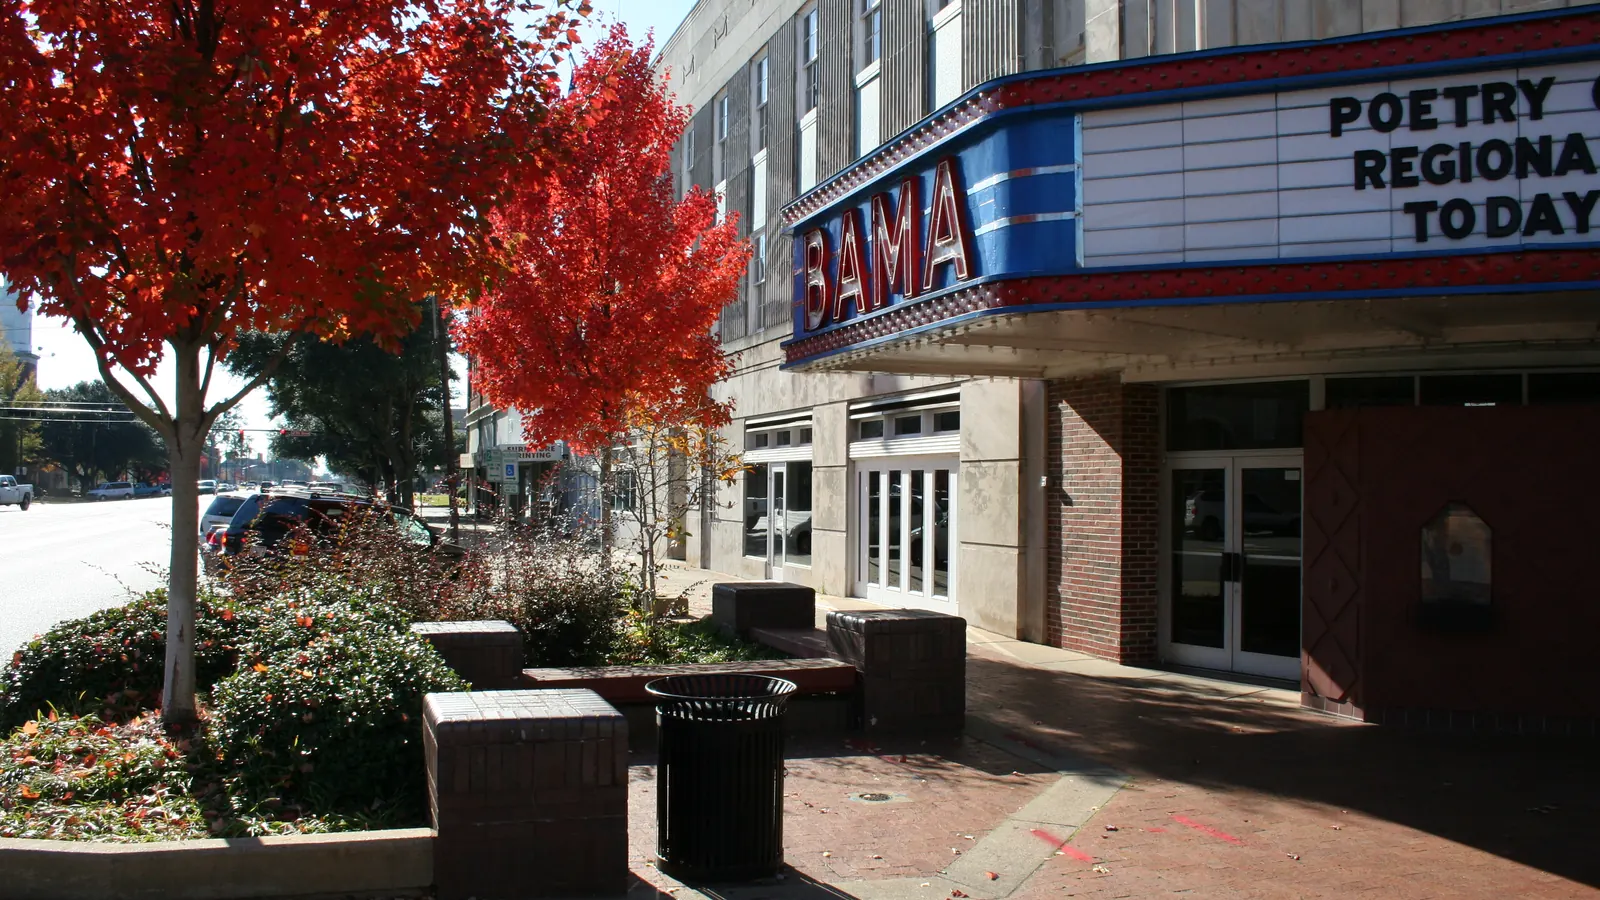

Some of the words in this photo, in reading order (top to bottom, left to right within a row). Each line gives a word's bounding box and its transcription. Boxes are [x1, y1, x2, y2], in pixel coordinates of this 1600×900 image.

[1330, 76, 1556, 138] POETRY
[1353, 132, 1598, 190] REGIONA
[803, 155, 975, 333] BAMA
[1403, 189, 1600, 243] TODAY
